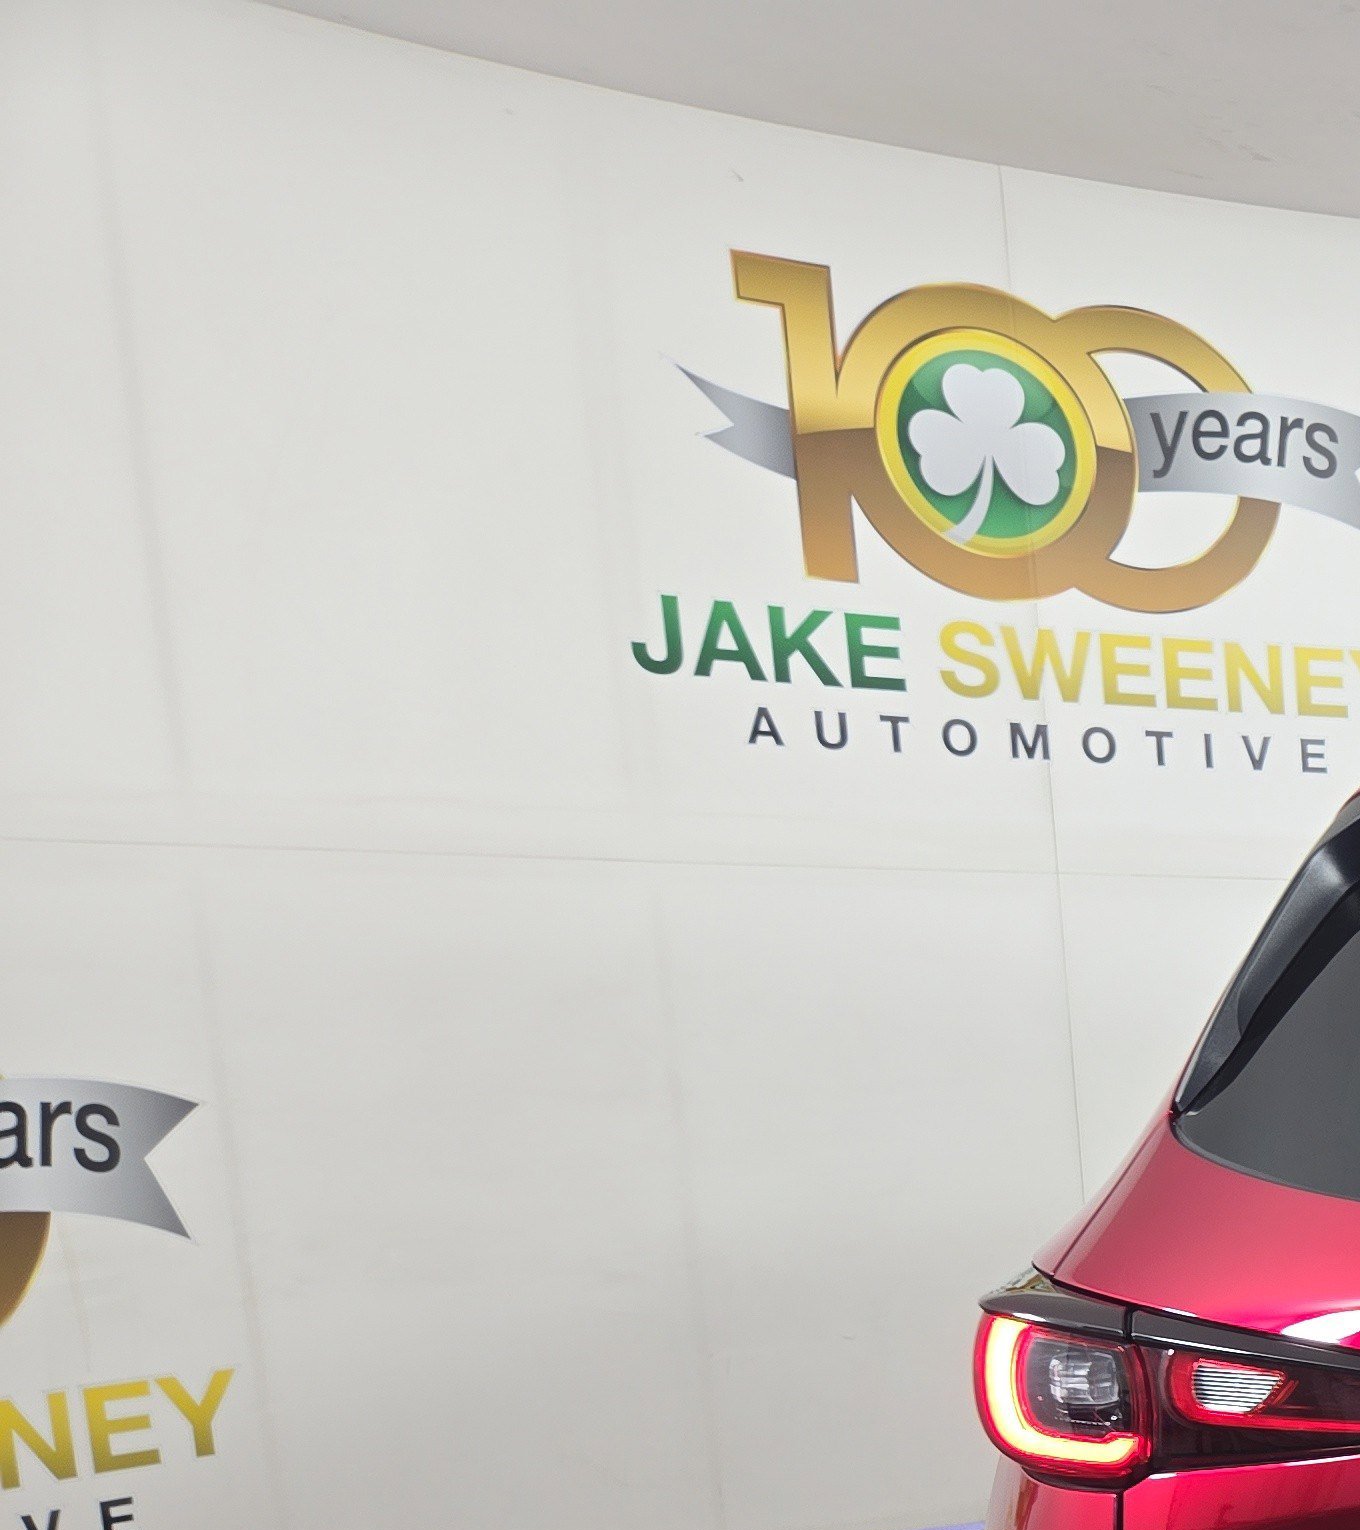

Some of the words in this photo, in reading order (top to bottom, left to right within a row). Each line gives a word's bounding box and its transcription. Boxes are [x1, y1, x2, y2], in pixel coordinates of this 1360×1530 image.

[729, 249, 1281, 613] 100
[1148, 404, 1340, 480] years
[630, 594, 908, 692] JAKE
[747, 706, 1329, 775] AUTOMOTIVE
